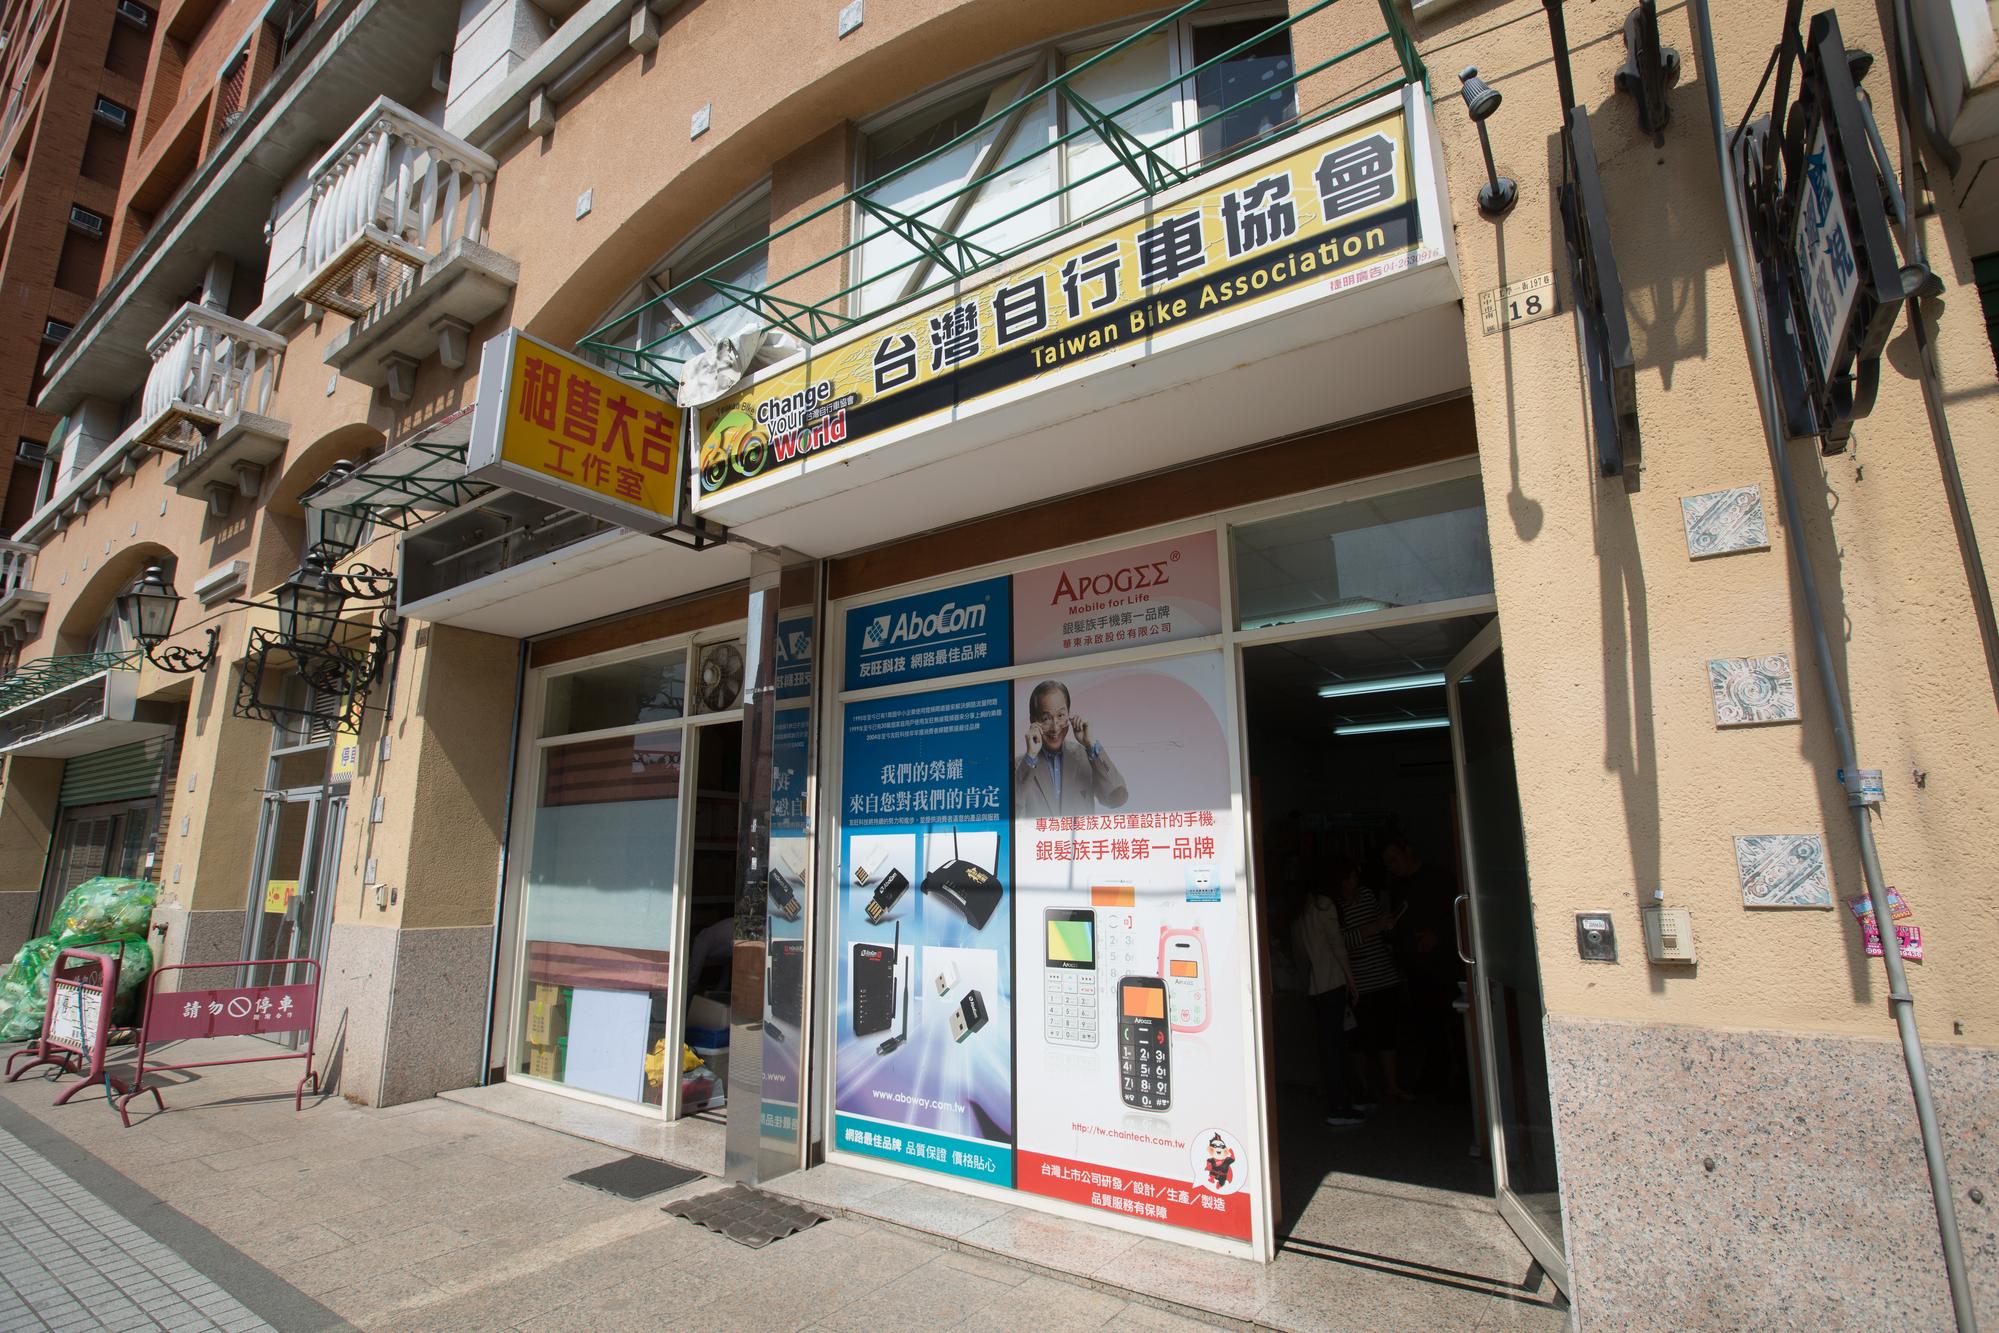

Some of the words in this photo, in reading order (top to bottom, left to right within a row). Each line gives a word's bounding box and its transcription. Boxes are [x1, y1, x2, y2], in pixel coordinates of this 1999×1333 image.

[873, 132, 1396, 393] 台灣自行車協會
[1030, 323, 1119, 368] Taiwan
[1130, 299, 1188, 334] Bike
[1199, 224, 1386, 310] Association
[1509, 295, 1542, 321] 18
[519, 355, 675, 476] 租售大吉
[756, 380, 831, 424] Change
[767, 408, 806, 441] your
[773, 409, 847, 462] World
[543, 438, 646, 501] 工作室
[1062, 605, 1171, 636] 銀髮族手機第一品牌
[1068, 602, 1106, 616] Mobile
[1108, 599, 1125, 609] for
[1127, 592, 1150, 605] Life
[890, 602, 986, 644] AboCom
[859, 656, 906, 678] 友旺科技
[910, 642, 988, 670] 網路最佳品牌
[881, 758, 963, 785] 我們的榮耀
[849, 785, 1000, 815] 來自您對我們的肯定
[1035, 836, 1215, 861] 銀髮族手機第一品牌
[872, 1088, 966, 1114] www.aboway.com.tw
[844, 1127, 903, 1153] 網路最佳品牌
[905, 1141, 948, 1164] 品質保證
[951, 1150, 997, 1174] 價格貼心
[1071, 1121, 1186, 1150] http://tw.chaintech.com.tw
[1090, 1192, 1168, 1220] 品質服務有保障
